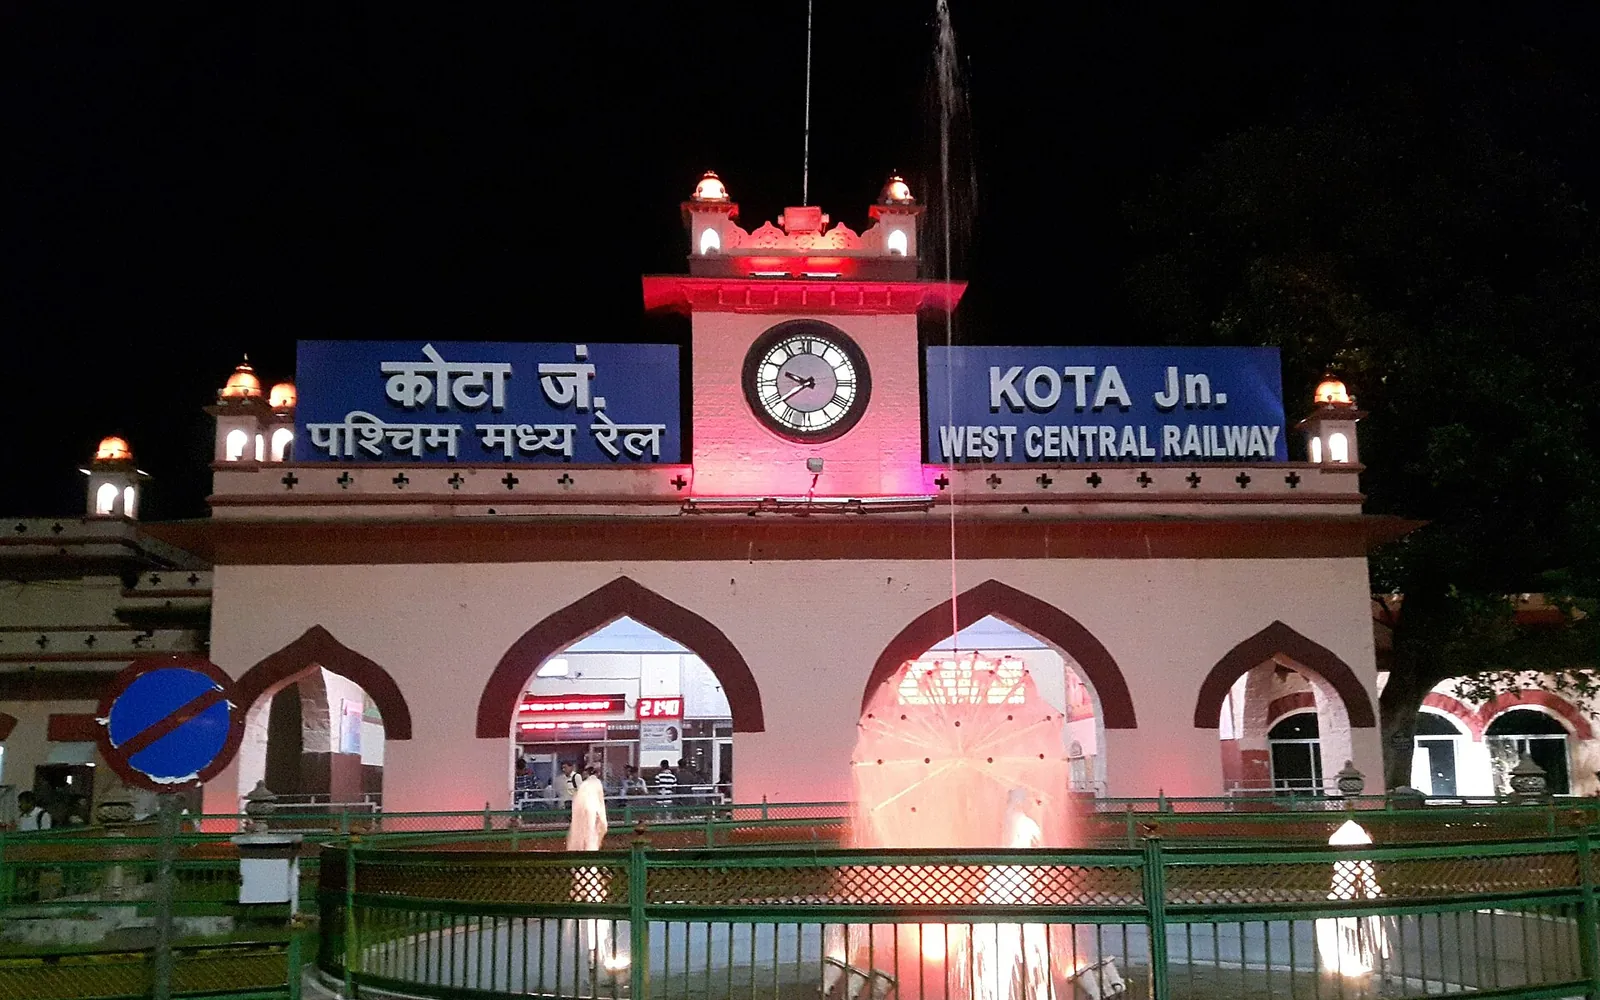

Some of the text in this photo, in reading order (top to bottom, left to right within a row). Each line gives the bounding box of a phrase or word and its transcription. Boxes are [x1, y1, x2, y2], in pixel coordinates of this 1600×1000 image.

[380, 343, 606, 409] कोटा जं.
[990, 365, 1228, 408] KOTA Jn.
[306, 410, 666, 458] पश्चिम मध्य रेल
[939, 424, 1280, 457] WEST CENTRAL RAILWAY
